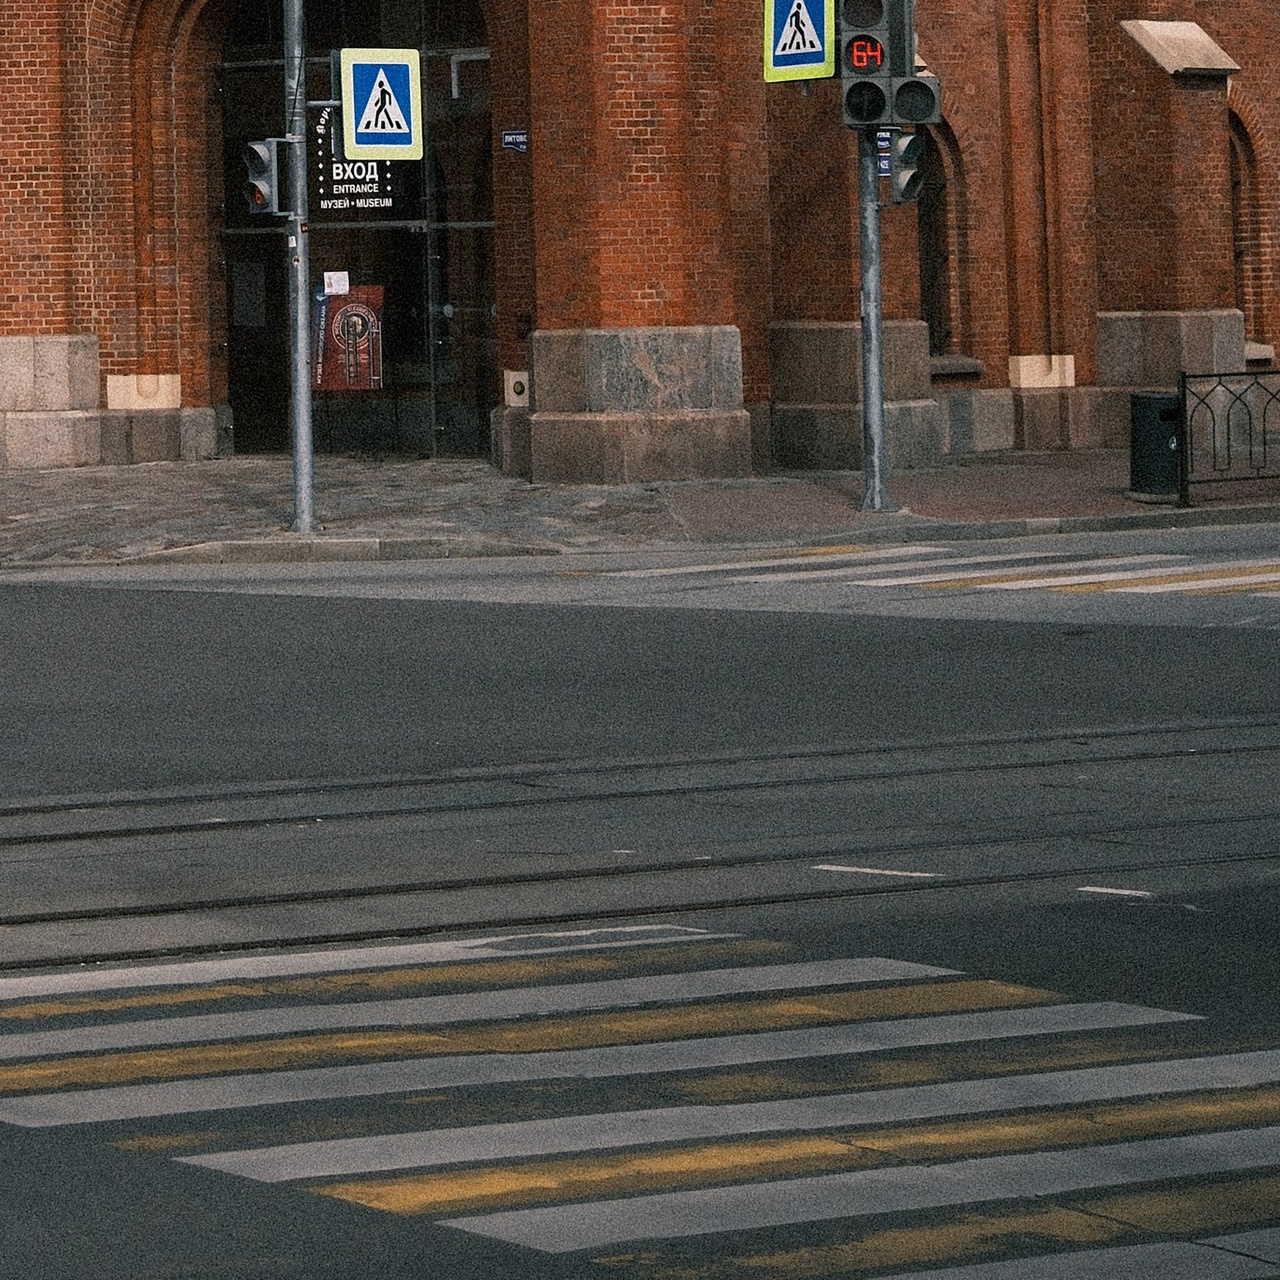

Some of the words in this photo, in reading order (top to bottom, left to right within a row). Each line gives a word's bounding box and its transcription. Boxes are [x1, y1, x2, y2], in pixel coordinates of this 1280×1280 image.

[852, 41, 882, 67] 64
[332, 162, 379, 182] ВХОД
[333, 183, 380, 194] ENTRANCE
[320, 197, 350, 209] МУЗЕЙ
[356, 197, 393, 208] MUSEUM
